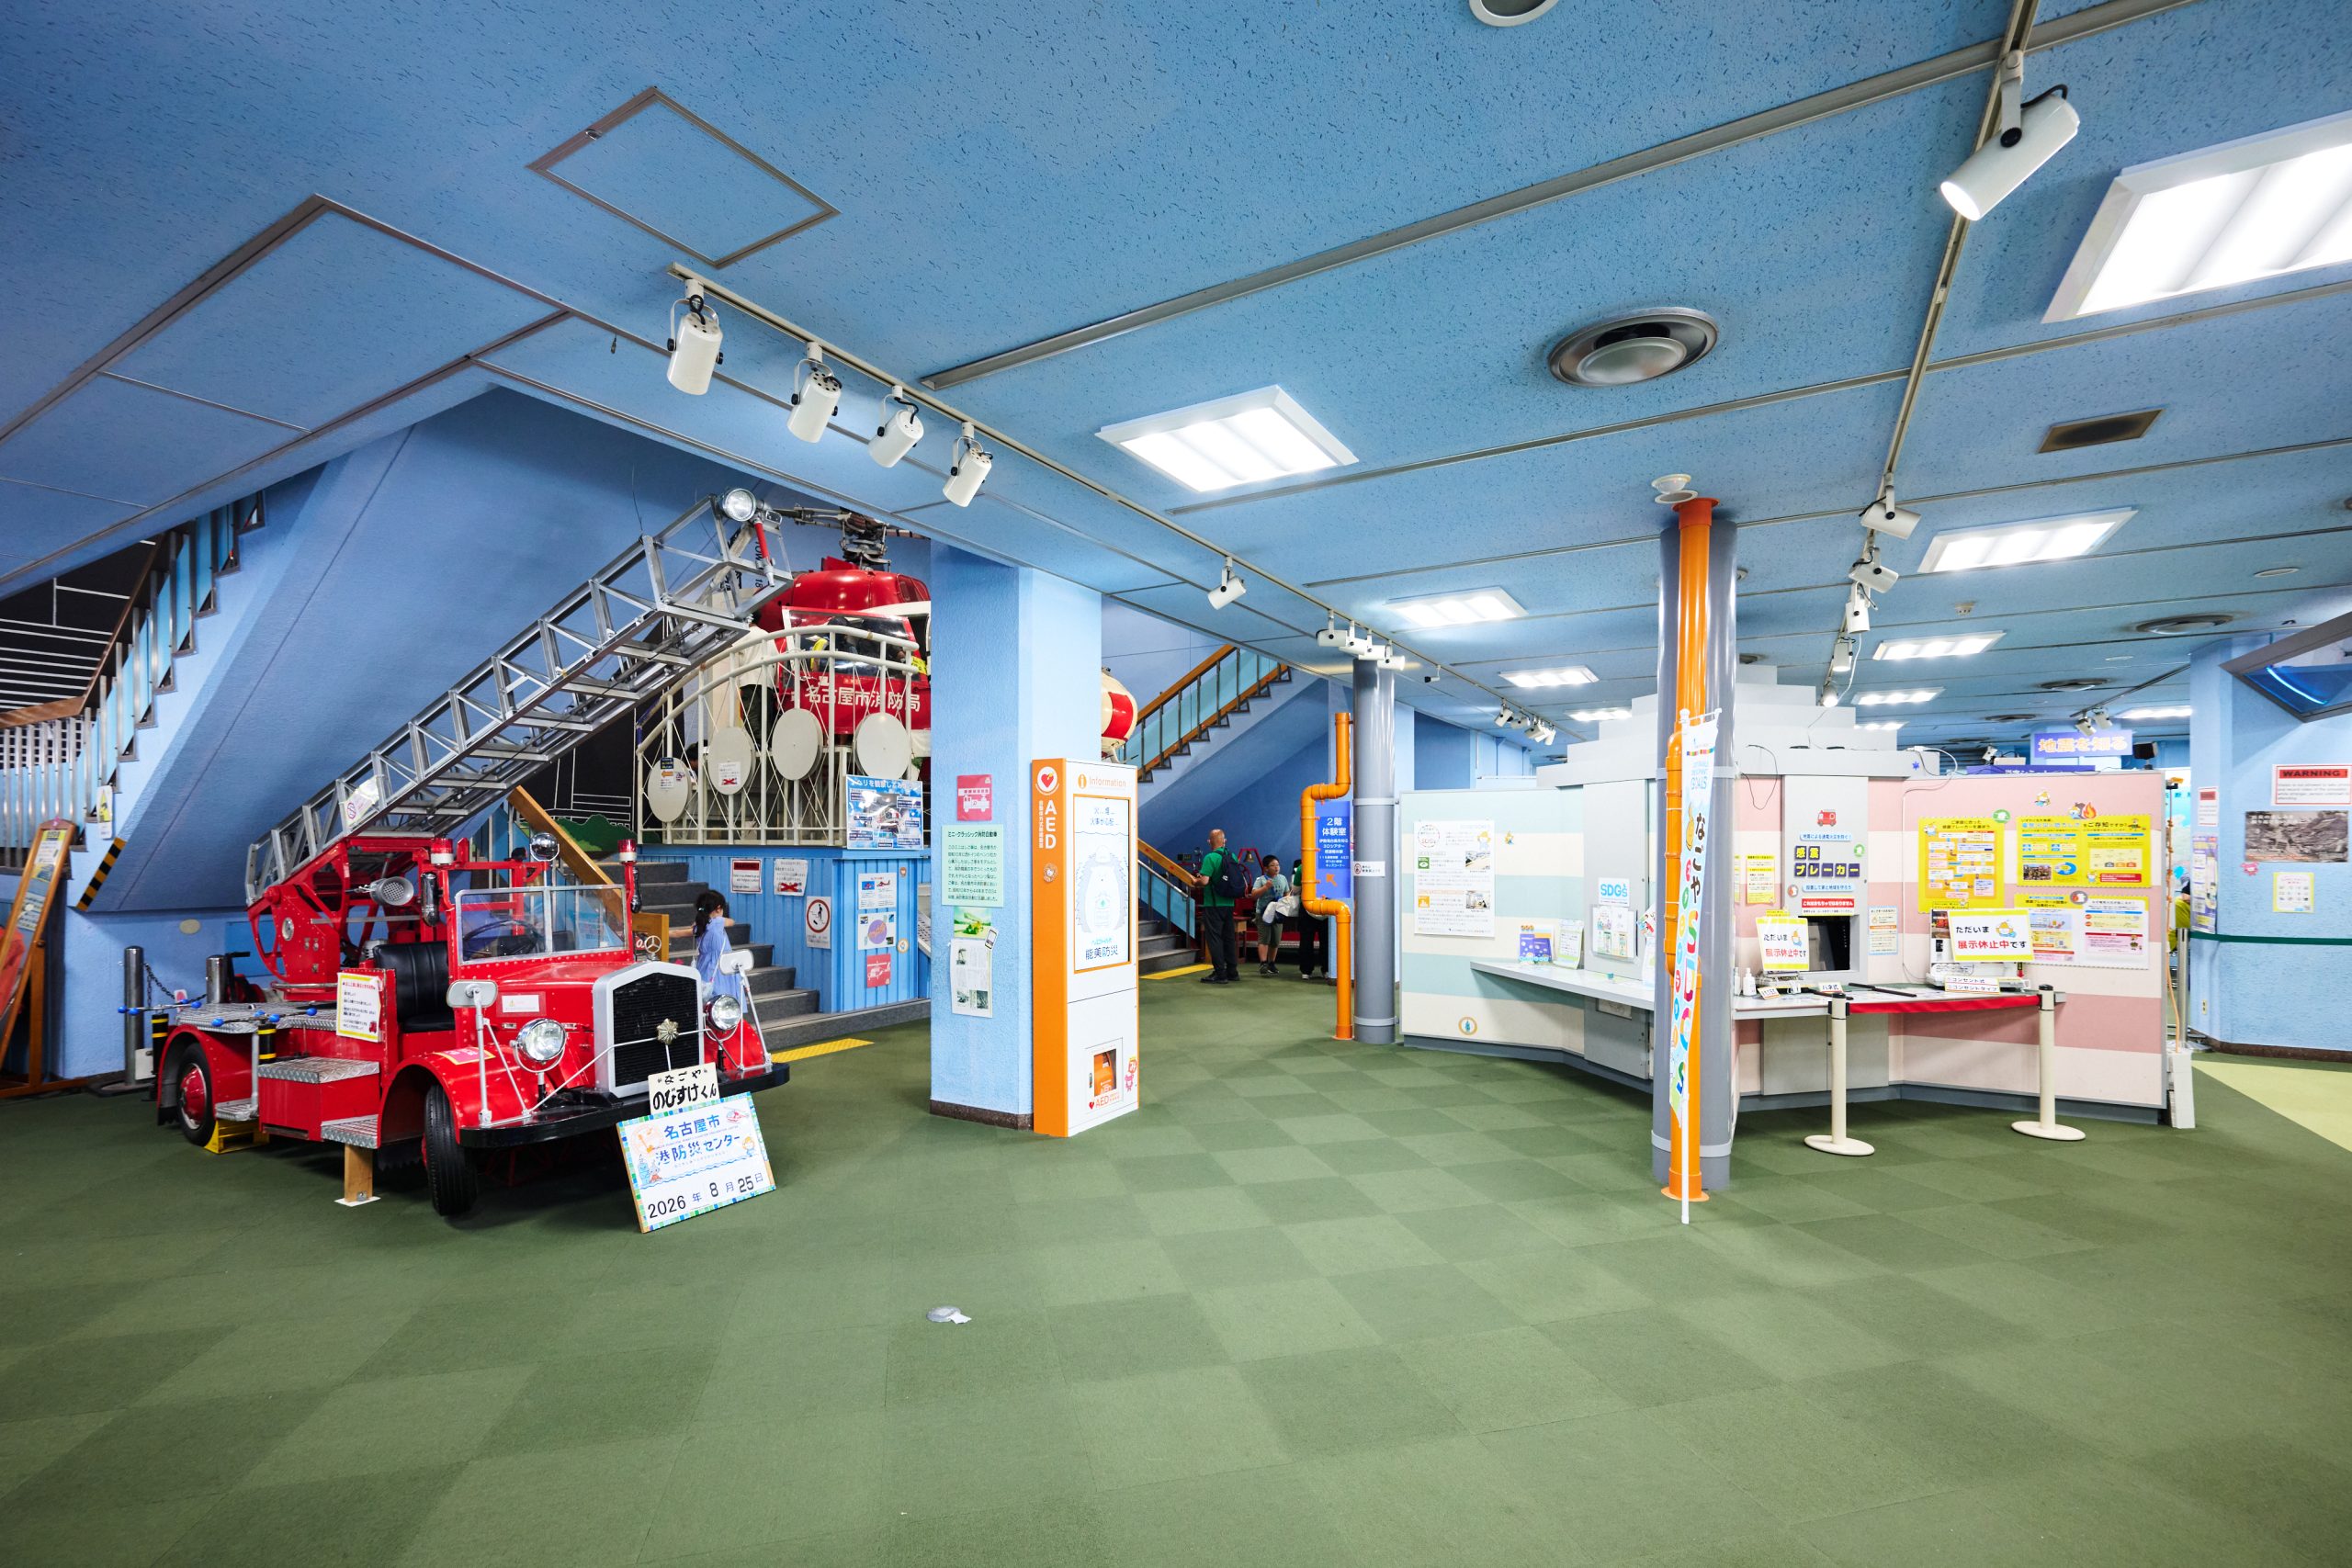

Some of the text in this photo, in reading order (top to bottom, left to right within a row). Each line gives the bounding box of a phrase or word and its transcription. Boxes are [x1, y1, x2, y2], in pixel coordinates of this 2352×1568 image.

[2039, 736, 2128, 753] 地震を知る
[1089, 777, 1126, 788] Information
[1045, 799, 1057, 849] AED
[1326, 817, 1342, 827] 2階
[1322, 828, 1347, 837] 体験室
[1690, 812, 1705, 904] なごや
[1796, 846, 1820, 859] 感震
[1796, 864, 1860, 875] ブレーカー
[1956, 925, 1990, 933] ただいま
[1763, 932, 1788, 942] ただいま
[1958, 940, 2026, 949] 展示休止中です
[1085, 944, 1118, 961] 能美防災
[1765, 948, 1807, 958] 展示休止中です
[652, 1082, 718, 1111] のびすけくん
[663, 1113, 720, 1141] 名古屋市
[655, 1134, 741, 1167] 港防災センター
[648, 1171, 764, 1220] 2026 年 8 月 25 日
